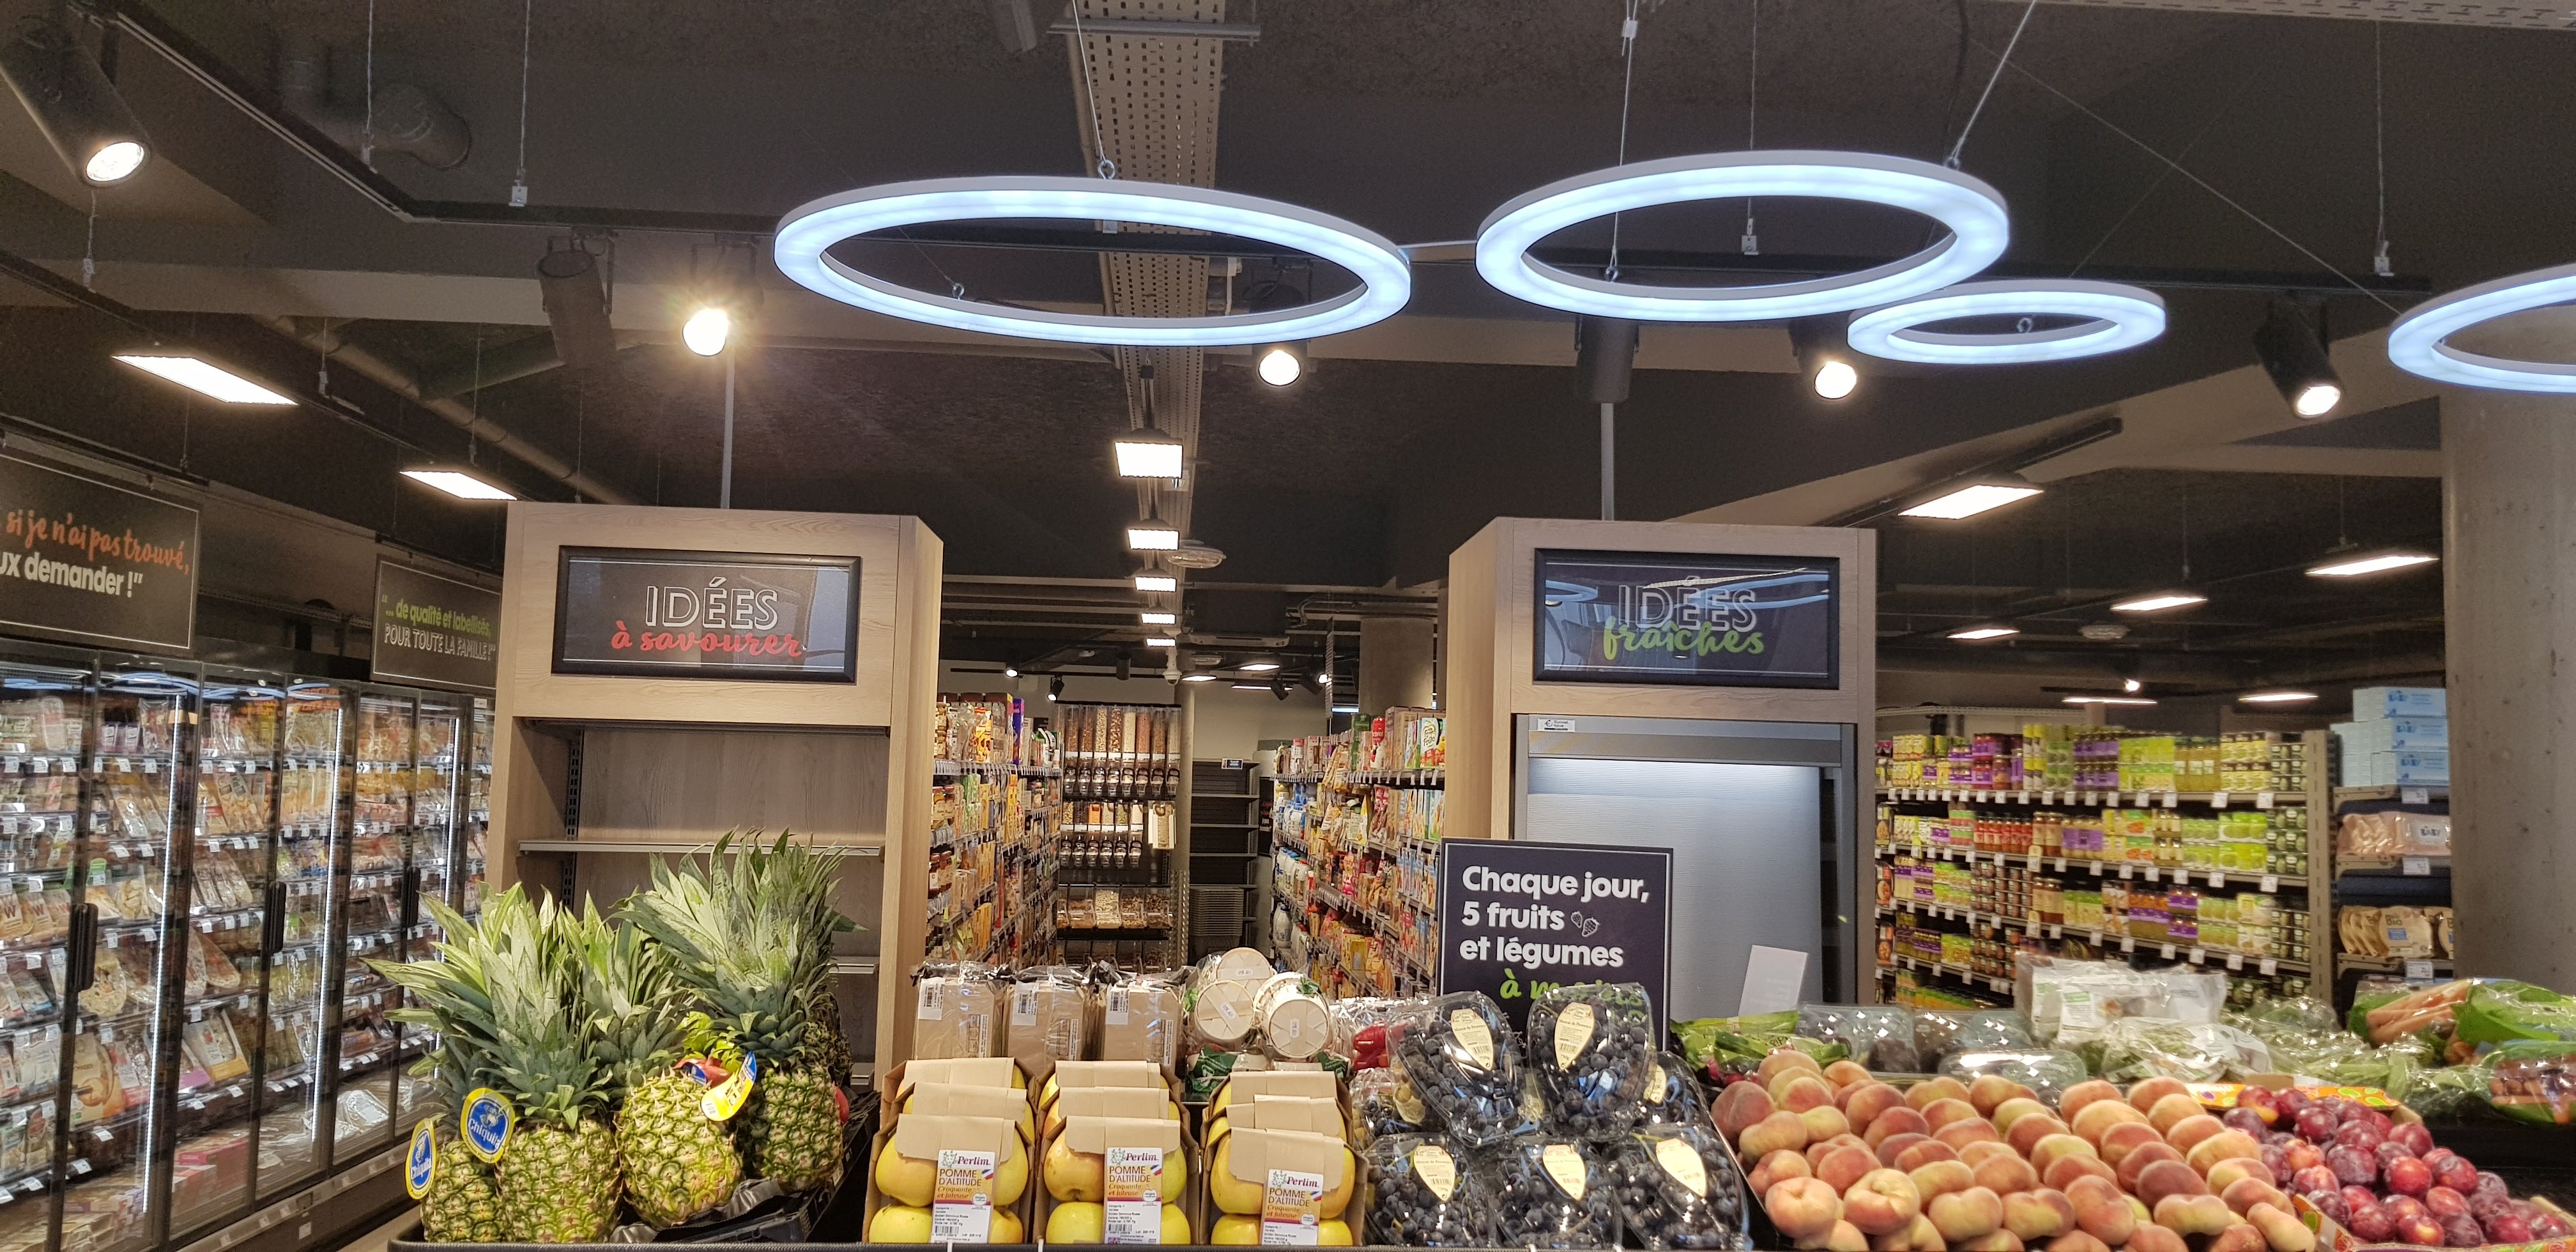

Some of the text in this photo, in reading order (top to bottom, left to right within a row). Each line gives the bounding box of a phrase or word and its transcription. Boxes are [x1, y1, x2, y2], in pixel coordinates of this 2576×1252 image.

[6, 509, 189, 574] si je n'ai pas trouvé,
[24, 552, 124, 595] demander
[396, 598, 409, 619] de
[410, 605, 441, 626] qualité
[443, 611, 452, 629] et
[645, 576, 778, 630] IDÉES
[1618, 576, 1757, 632] IDÉES
[385, 623, 411, 647] POUR
[413, 629, 443, 653] TOUTE
[445, 635, 455, 655] LA
[457, 637, 486, 660] FAMILLE
[611, 620, 802, 657] à savourer
[1602, 615, 1765, 661] fraîches
[1462, 866, 1650, 903] Chaque jour,
[1461, 901, 1565, 931] 5 fruits
[1459, 936, 1624, 970] et légumes
[1499, 968, 1522, 999] à
[468, 1118, 502, 1150] Chiquita
[410, 1157, 433, 1180] Chiquita
[939, 1177, 982, 1186] D'ALTITUDE
[940, 1168, 977, 1178] POMME
[1109, 1166, 1146, 1174] POMME
[1268, 1196, 1310, 1207] D'ALTITUDE
[1268, 1204, 1300, 1212] Croquante
[1269, 1187, 1306, 1199] POMME
